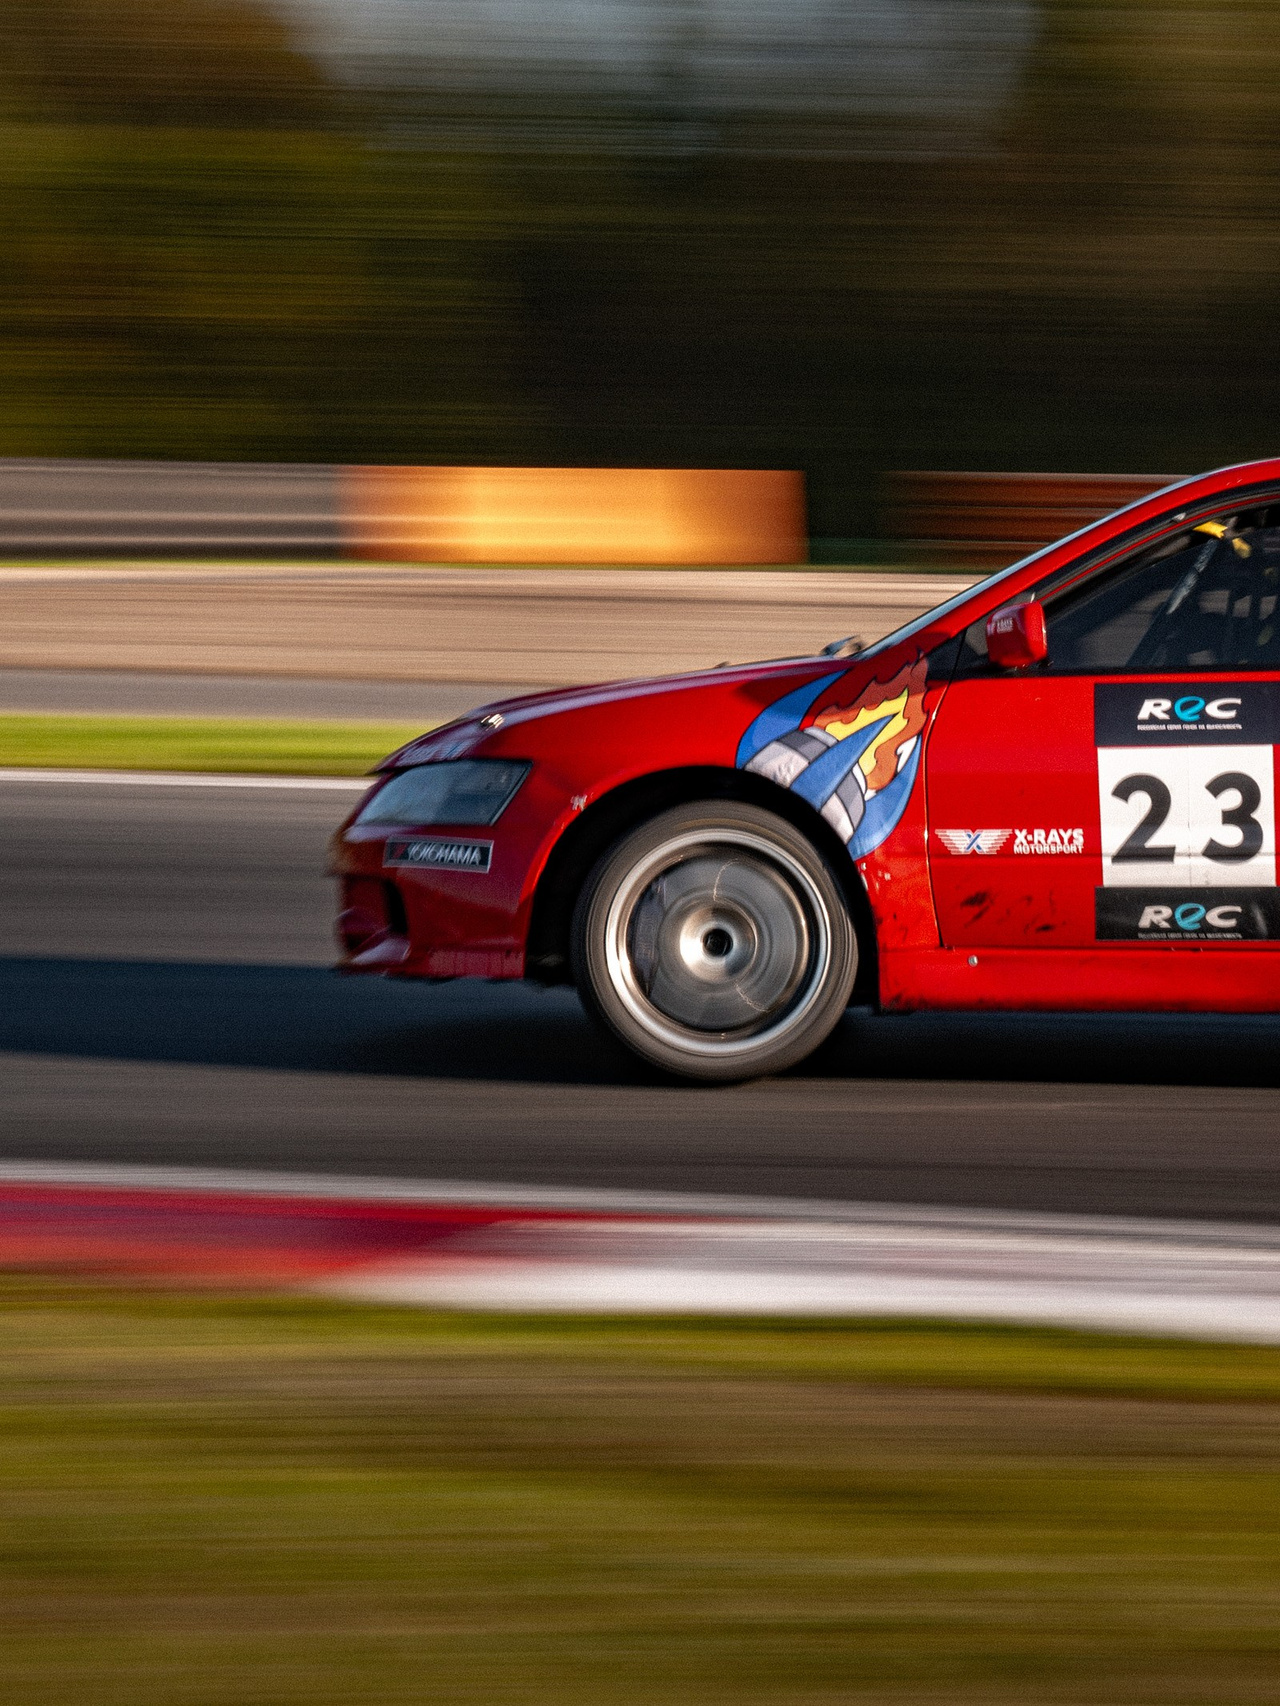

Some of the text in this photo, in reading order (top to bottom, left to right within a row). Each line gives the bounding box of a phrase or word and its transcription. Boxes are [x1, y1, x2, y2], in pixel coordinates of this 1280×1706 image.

[1111, 770, 1264, 865] 23
[1014, 828, 1084, 844] X-RAYS
[407, 842, 481, 866] YOKOHAMA
[1013, 844, 1084, 855] MOTORSPORT
